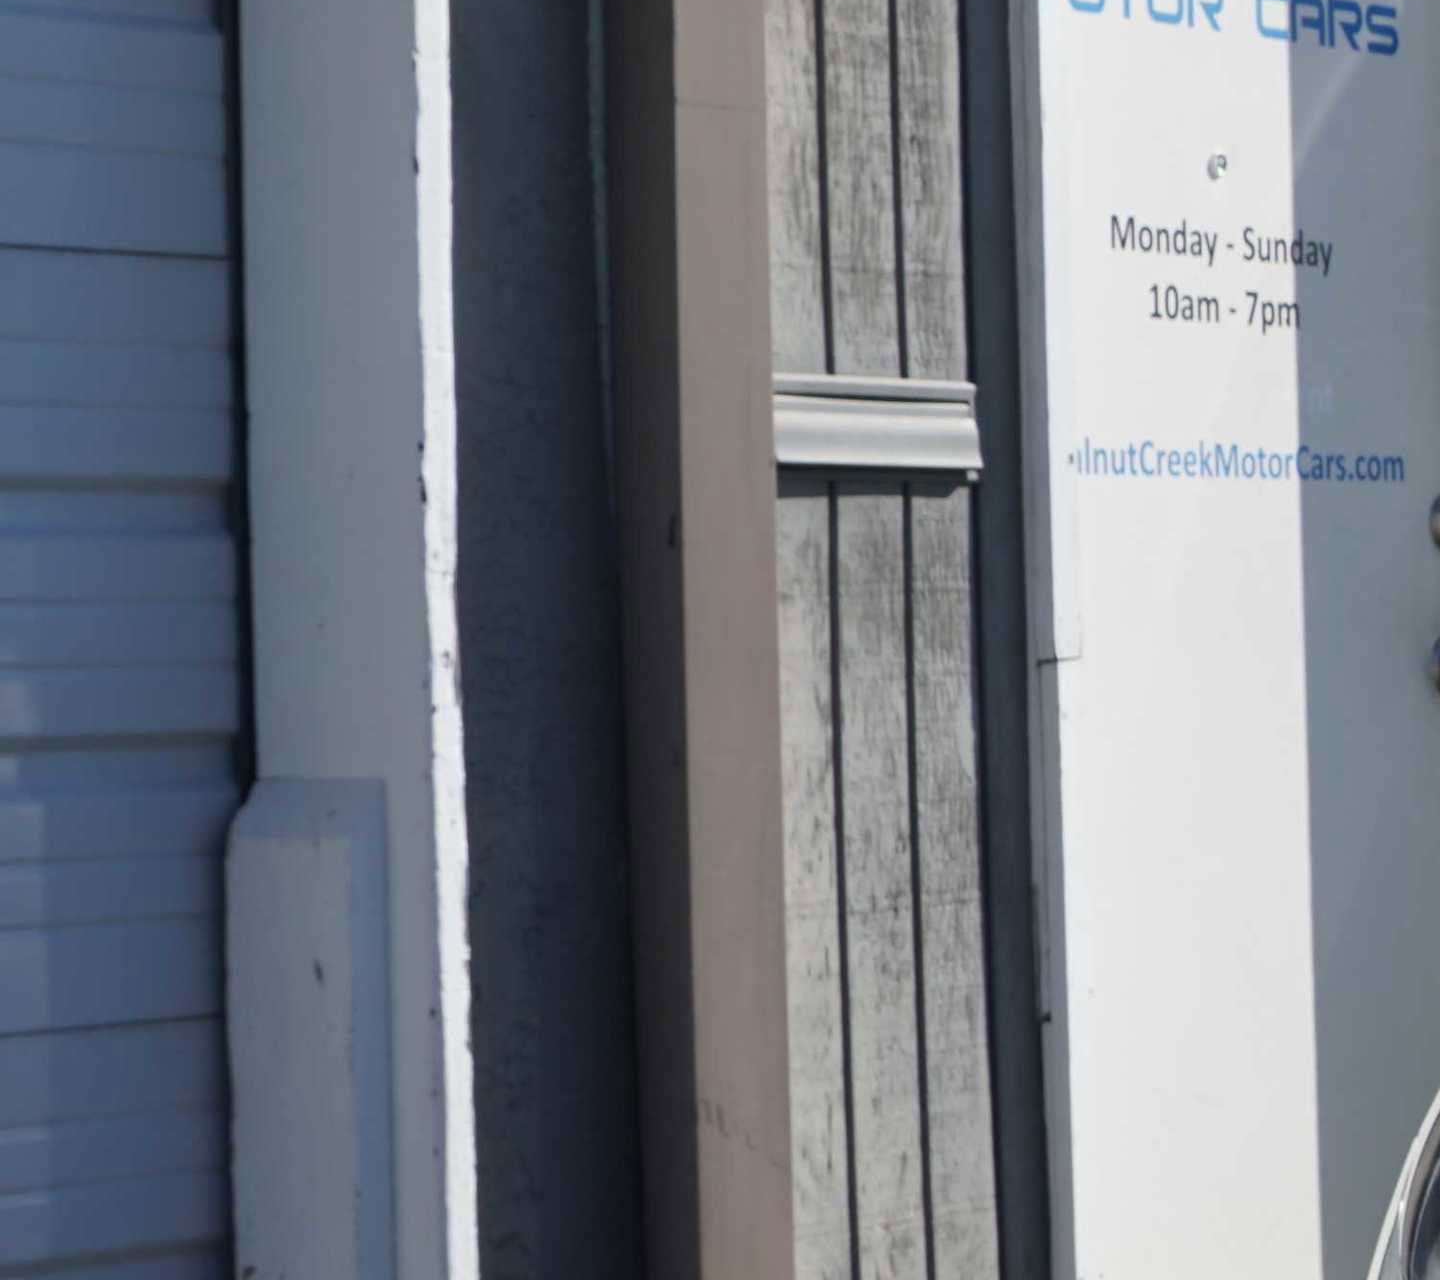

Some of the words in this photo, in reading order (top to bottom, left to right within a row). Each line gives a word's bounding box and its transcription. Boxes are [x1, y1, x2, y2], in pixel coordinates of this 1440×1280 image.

[1110, 214, 1217, 267] Monday
[1243, 227, 1333, 277] Sunday
[1150, 283, 1220, 323] 10am
[1246, 292, 1300, 334] 7pm
[1076, 436, 1405, 481] lnutCreekMotorCars.com
